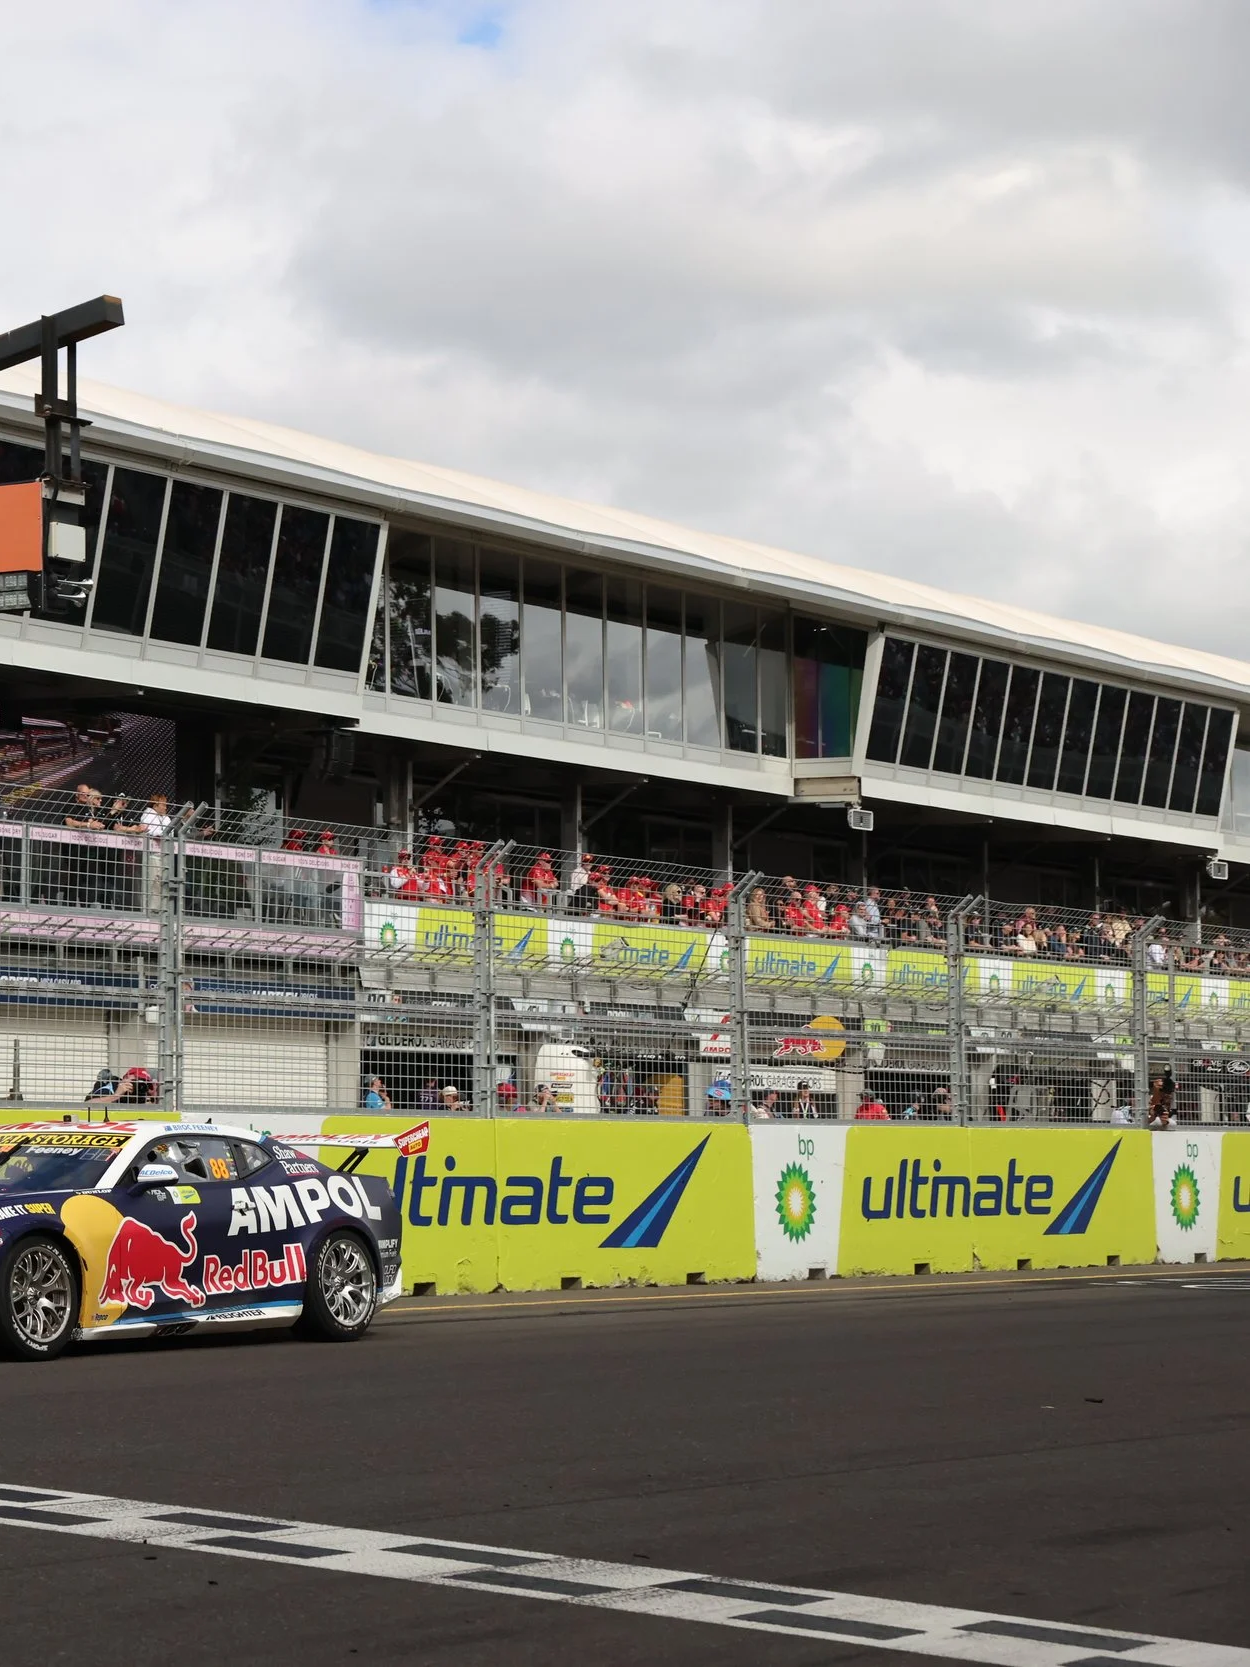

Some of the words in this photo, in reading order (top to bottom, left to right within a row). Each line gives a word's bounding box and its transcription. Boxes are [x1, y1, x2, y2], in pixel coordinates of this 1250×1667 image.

[425, 924, 503, 951] ultime
[754, 950, 817, 977] ultimate
[893, 964, 949, 985] ultimate
[703, 1046, 731, 1054] AMPO
[31, 1134, 127, 1147] STORAGE
[397, 1126, 429, 1148] SUPERCHEAP
[409, 1141, 422, 1152] AUTO
[798, 1134, 815, 1160] bp
[25, 1146, 84, 1157] Feeney
[272, 1146, 297, 1160] Shaw
[1186, 1139, 1199, 1162] bp
[209, 1158, 230, 1180] 88
[279, 1160, 319, 1175] Partners
[390, 1156, 615, 1227] ltimate
[861, 1158, 1054, 1220] ultimate
[16, 1204, 28, 1216] IT
[25, 1202, 57, 1215] SUPER
[227, 1175, 382, 1236] AMPOL
[203, 1248, 251, 1296] Red
[251, 1242, 308, 1290] Bull
